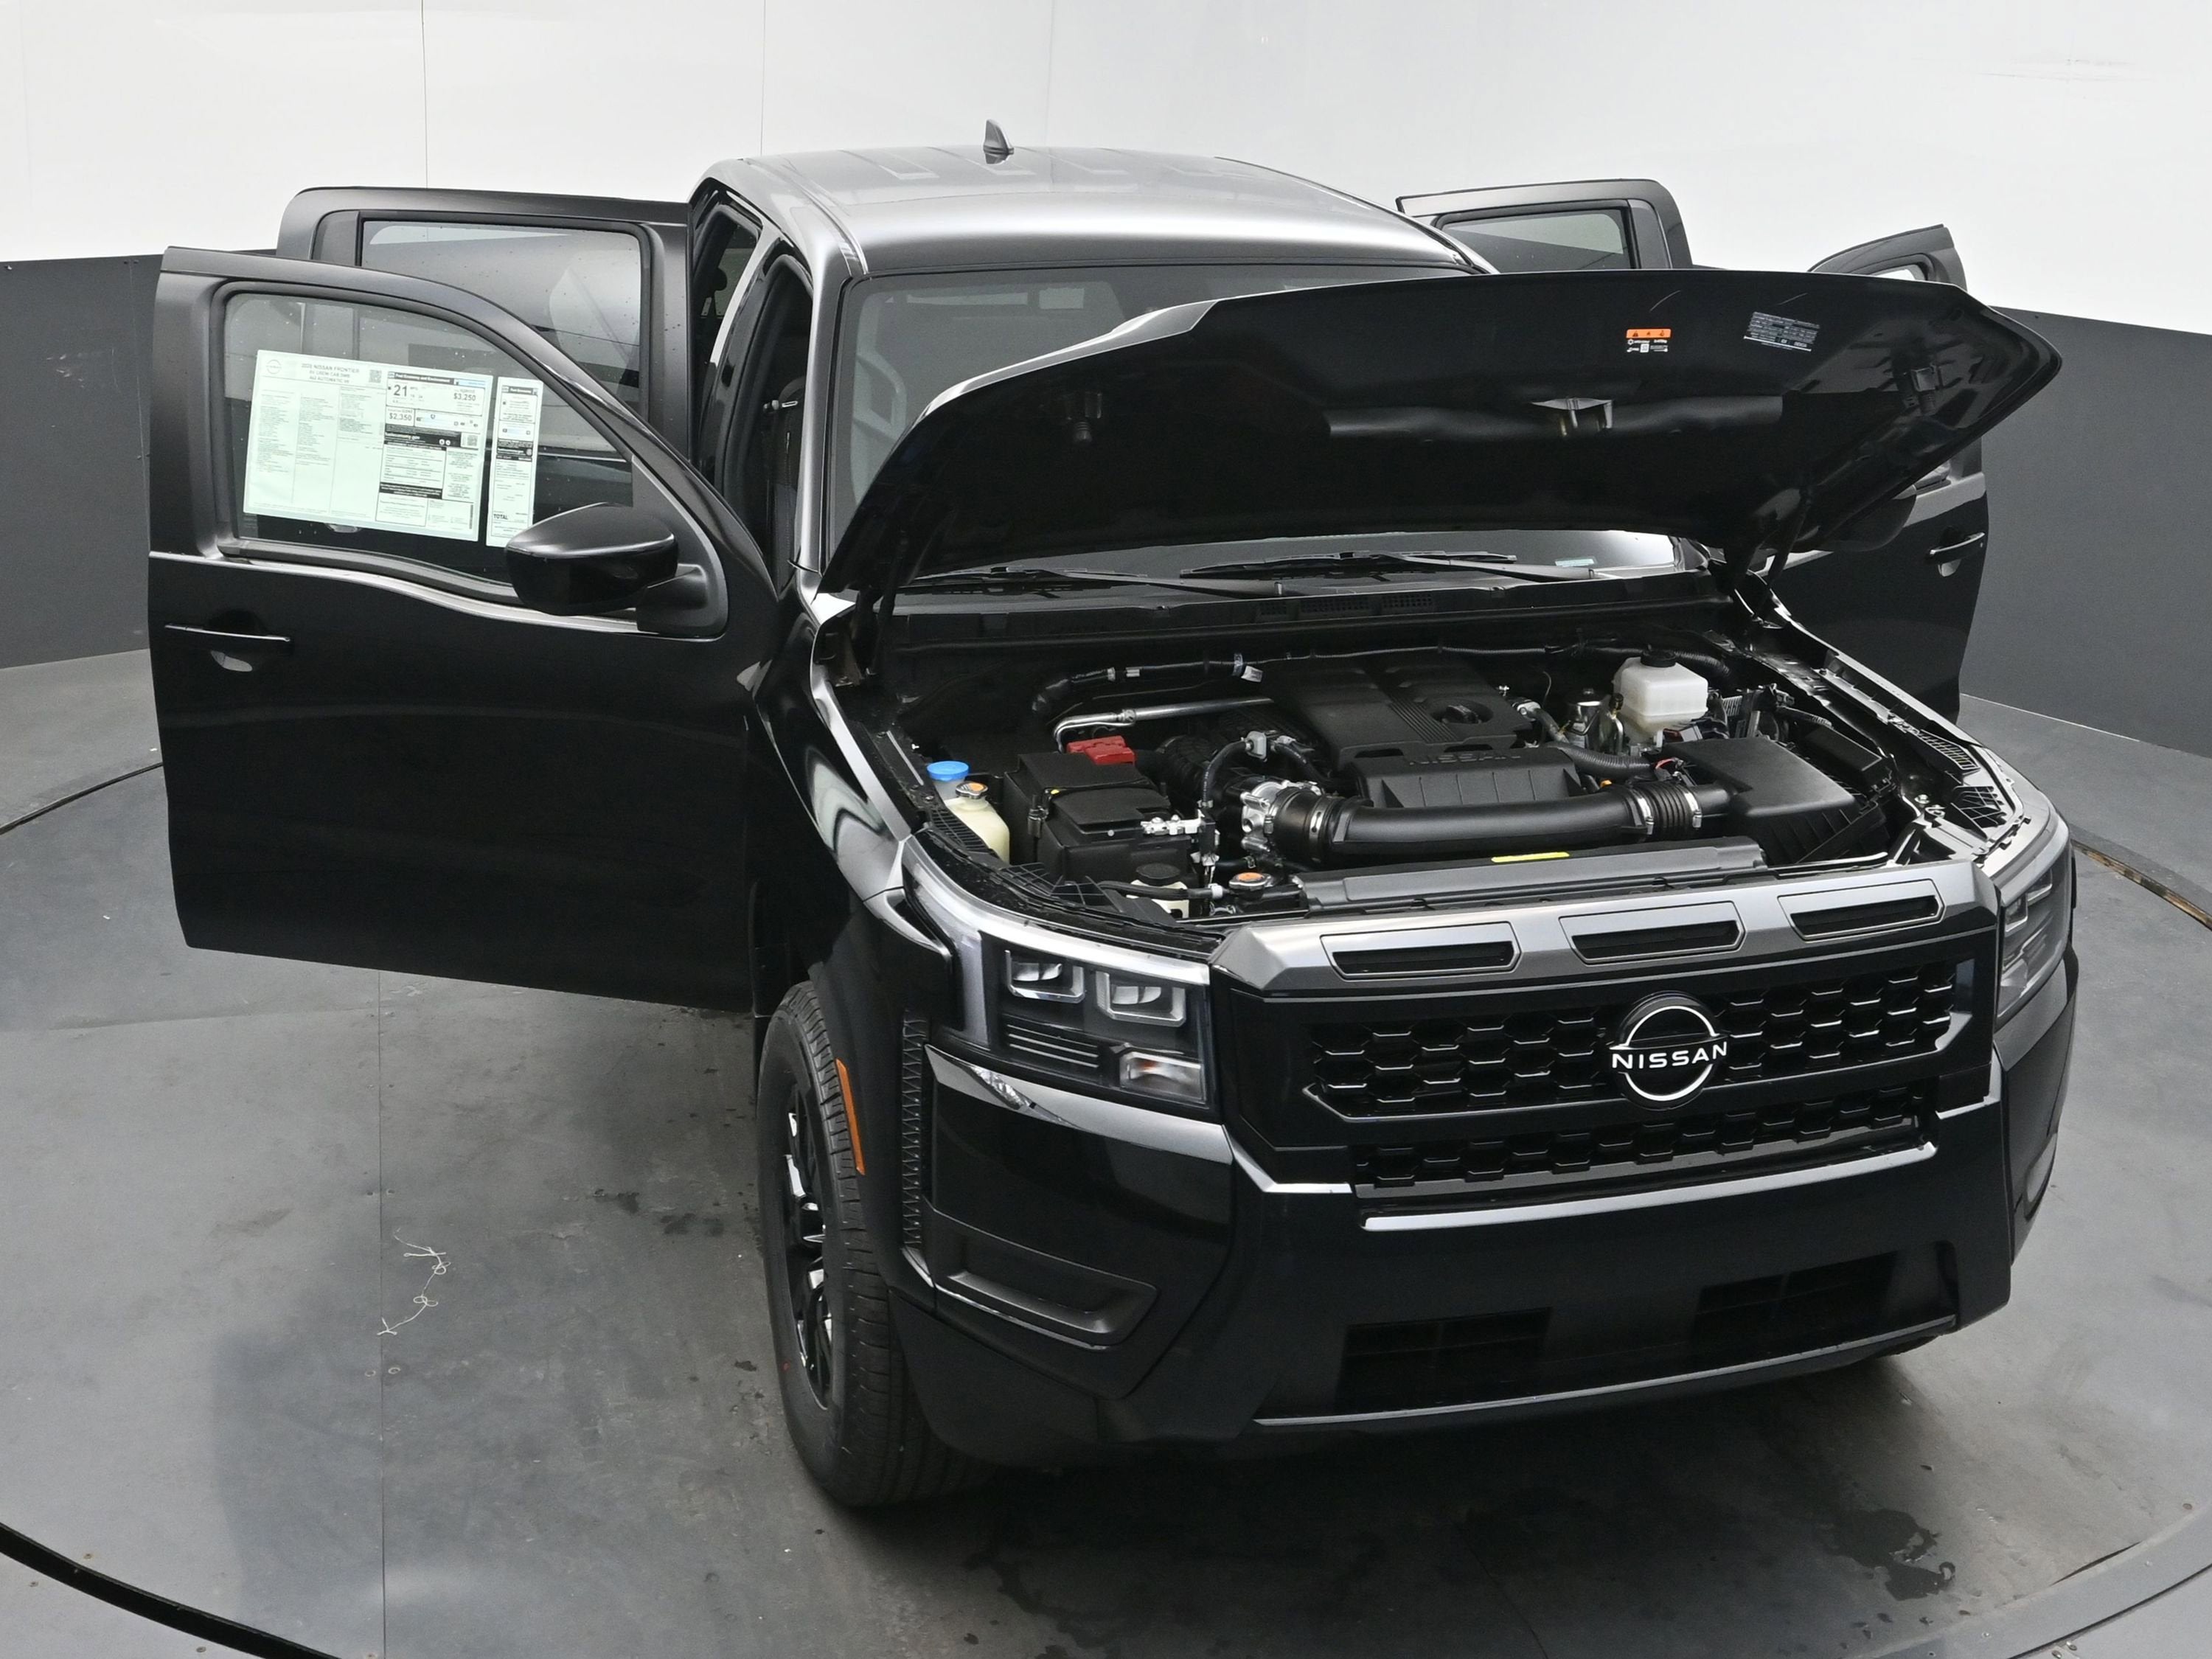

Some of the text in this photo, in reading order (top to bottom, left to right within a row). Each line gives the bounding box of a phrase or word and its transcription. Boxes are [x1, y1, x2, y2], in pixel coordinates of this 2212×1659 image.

[394, 384, 407, 397] 21
[453, 392, 476, 402] $3,250
[389, 412, 412, 421] $2,350
[1612, 1041, 1728, 1069] NISSAN
